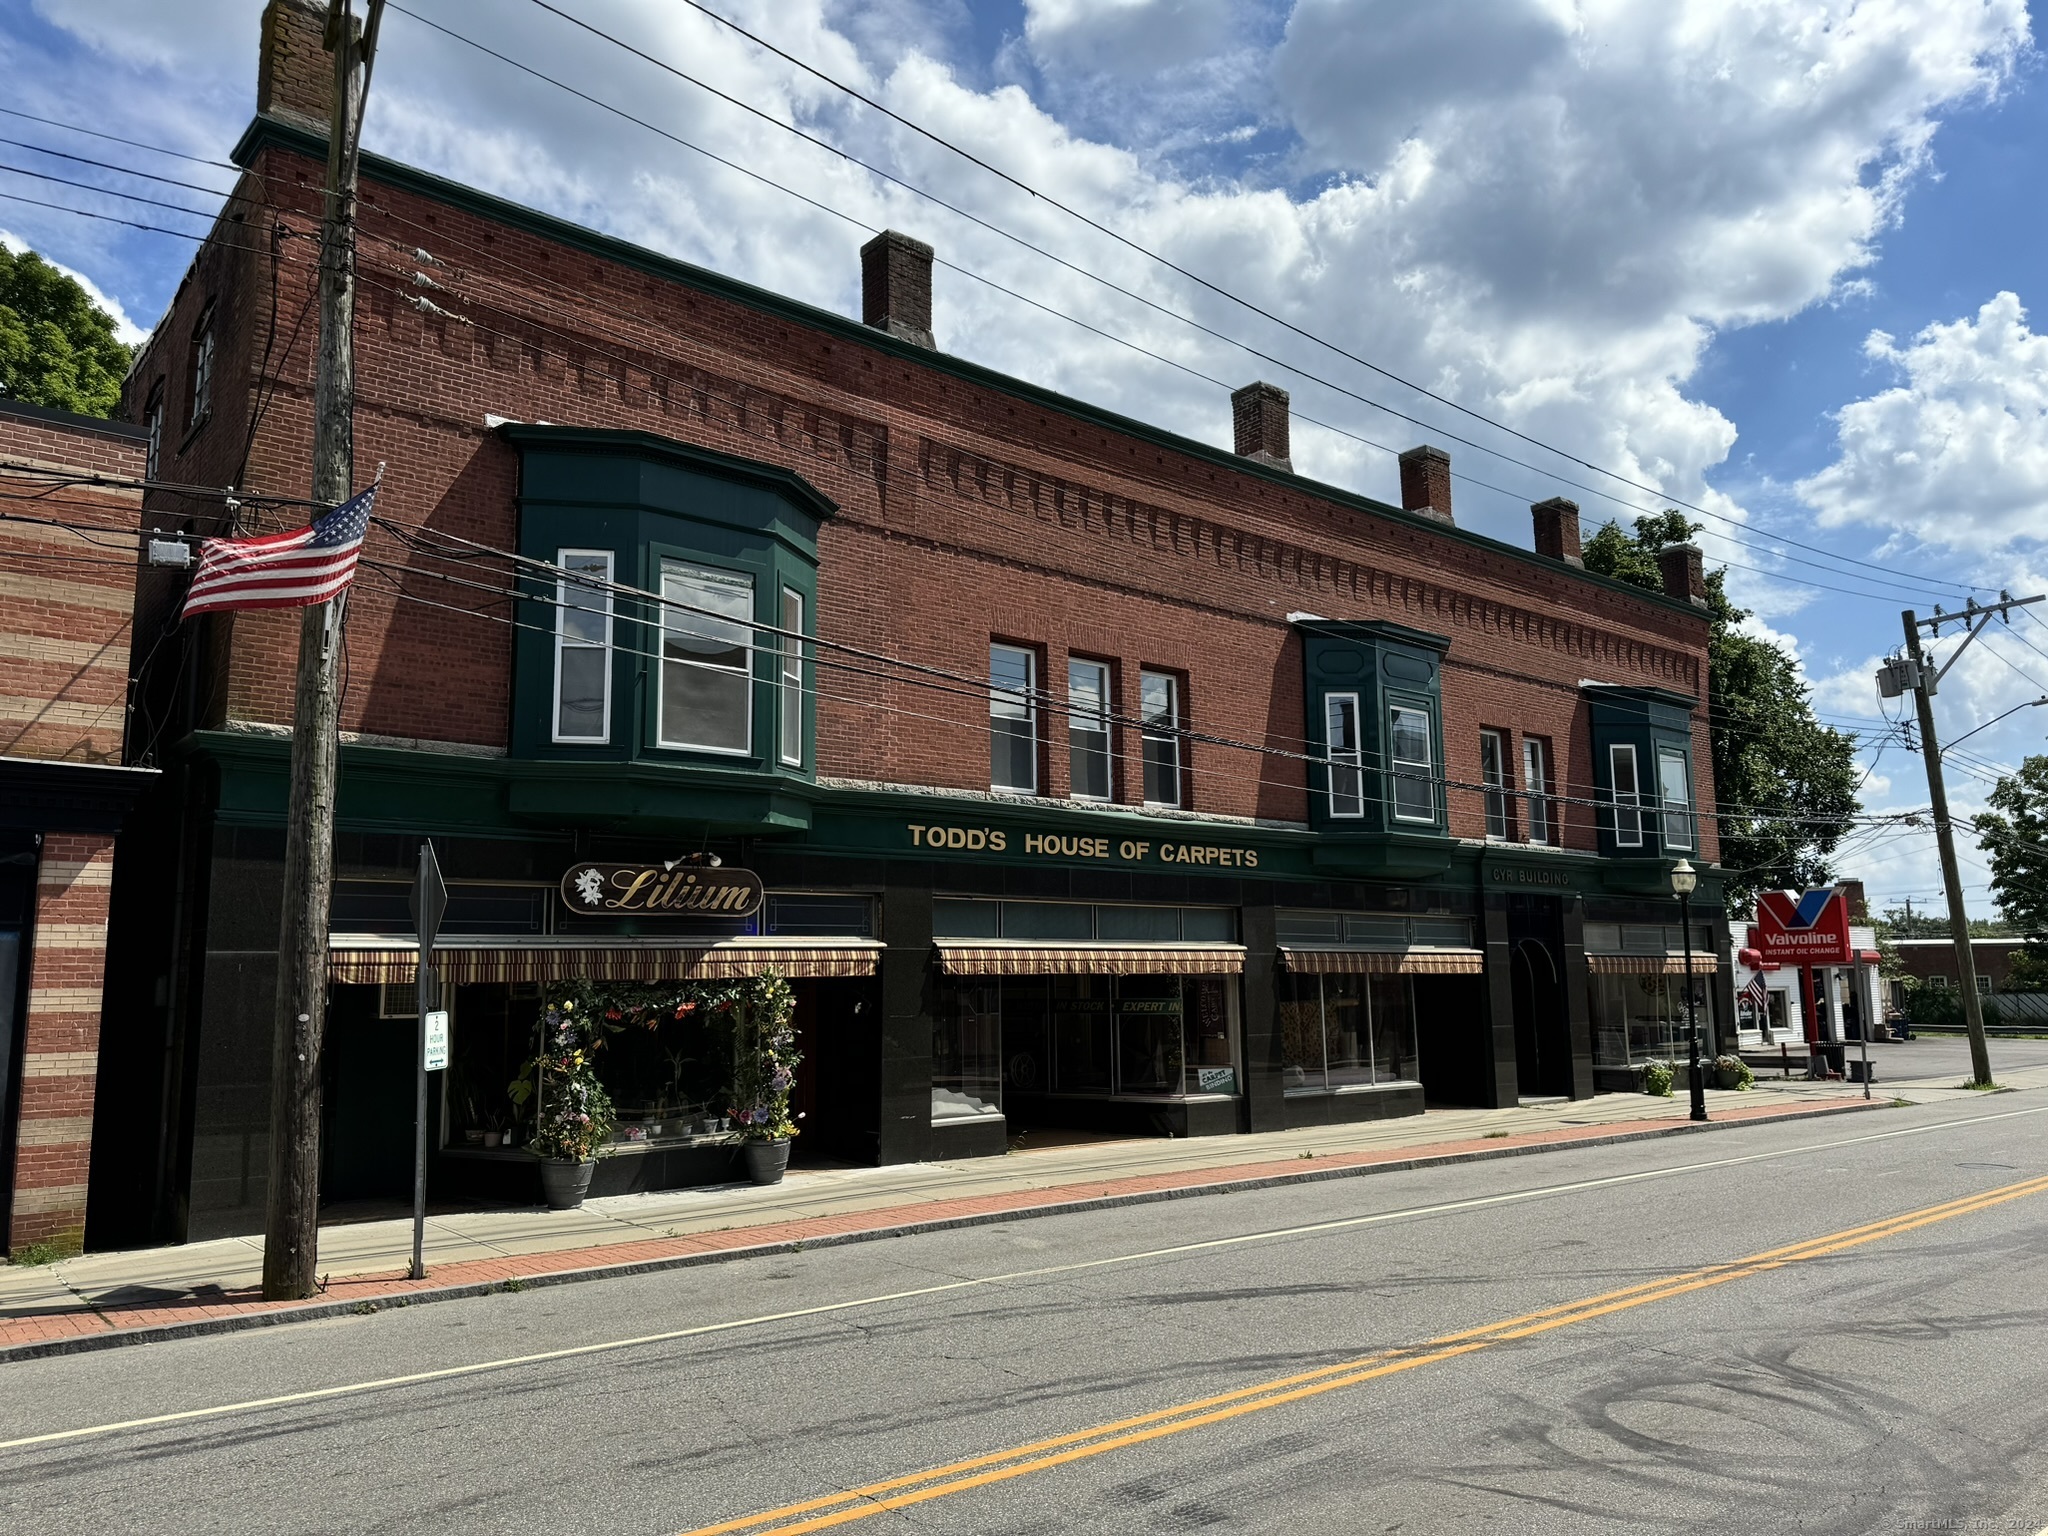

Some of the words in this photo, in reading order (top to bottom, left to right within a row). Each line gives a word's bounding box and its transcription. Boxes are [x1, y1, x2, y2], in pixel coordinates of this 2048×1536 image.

[908, 824, 1006, 851] TODD'S
[1025, 833, 1110, 858] HOUSE
[1120, 841, 1150, 861] OF
[1160, 843, 1258, 867] CARPETS
[1493, 868, 1512, 881] CYR
[1519, 870, 1569, 885] BUILDING
[605, 869, 751, 910] Lilium
[1764, 932, 1838, 946] Valvoline
[1765, 948, 1795, 956] INSTANT
[1809, 946, 1840, 955] CHANGE
[1070, 1001, 1104, 1011] STOCK
[1122, 1001, 1166, 1012] EXPERT
[434, 1020, 439, 1031] 2
[430, 1033, 444, 1044] HOUR
[427, 1045, 446, 1057] PARKING
[1202, 1069, 1226, 1083] CARPET
[1205, 1075, 1233, 1090] BINDING
